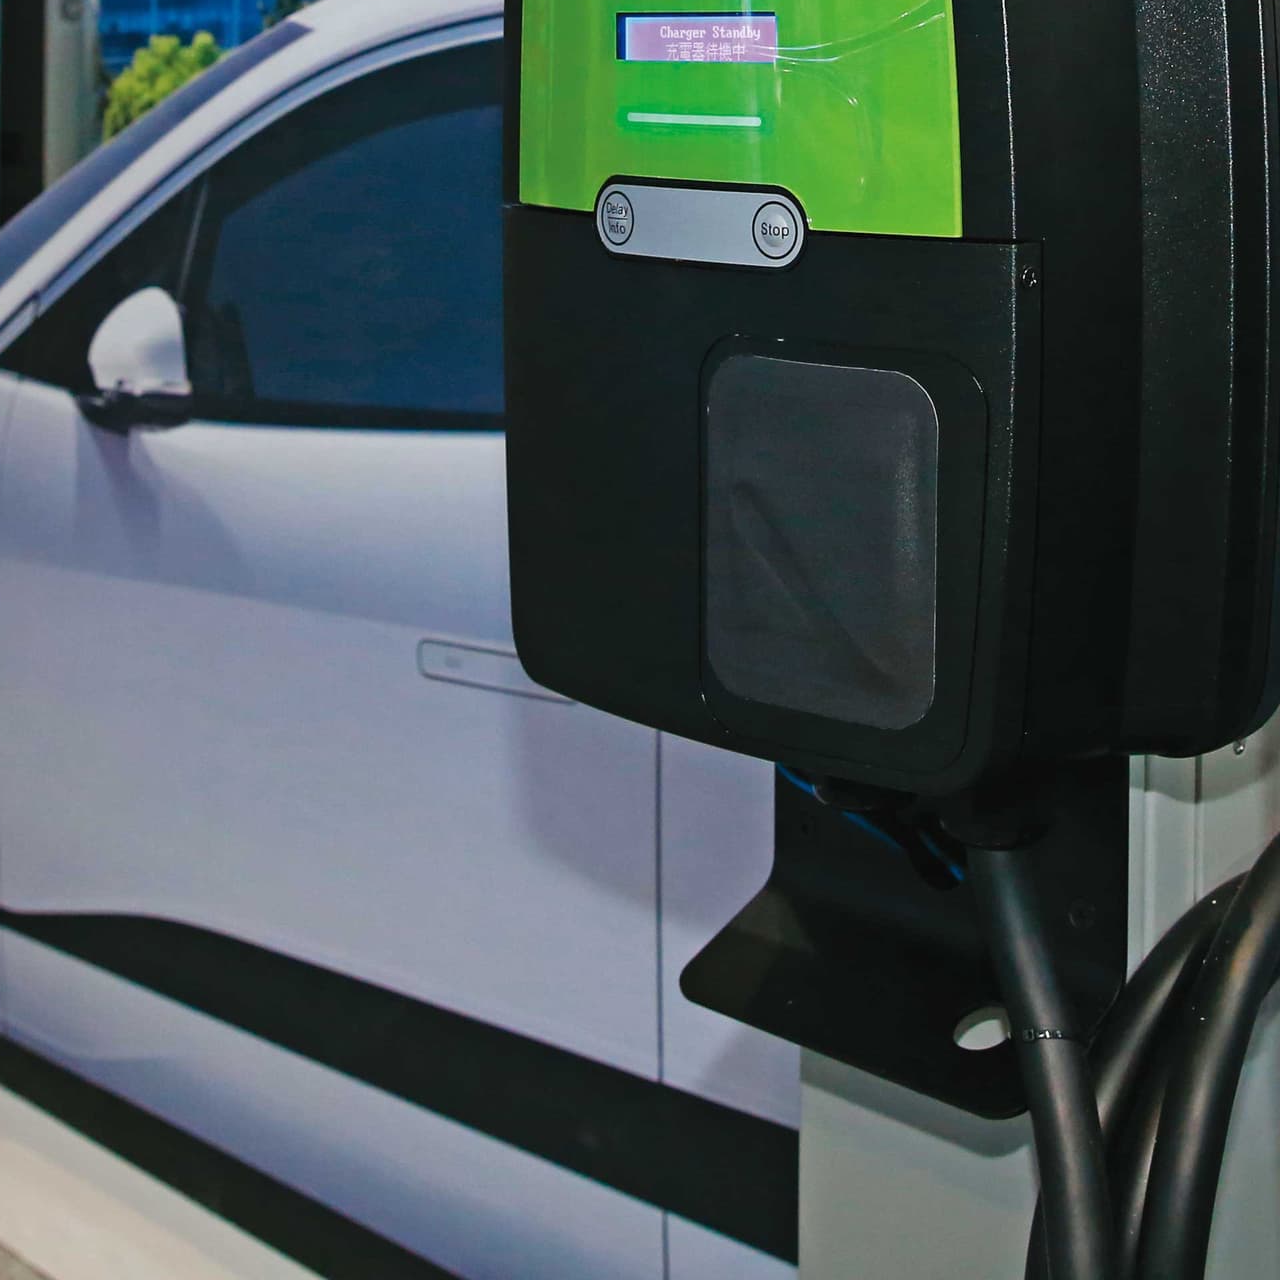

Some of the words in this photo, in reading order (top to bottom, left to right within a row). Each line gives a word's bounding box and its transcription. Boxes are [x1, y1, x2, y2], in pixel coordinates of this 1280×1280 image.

[659, 25, 707, 41] Charger
[712, 25, 761, 40] Standby
[606, 202, 629, 218] Delay
[608, 220, 626, 235] Info
[760, 222, 790, 239] Stop
